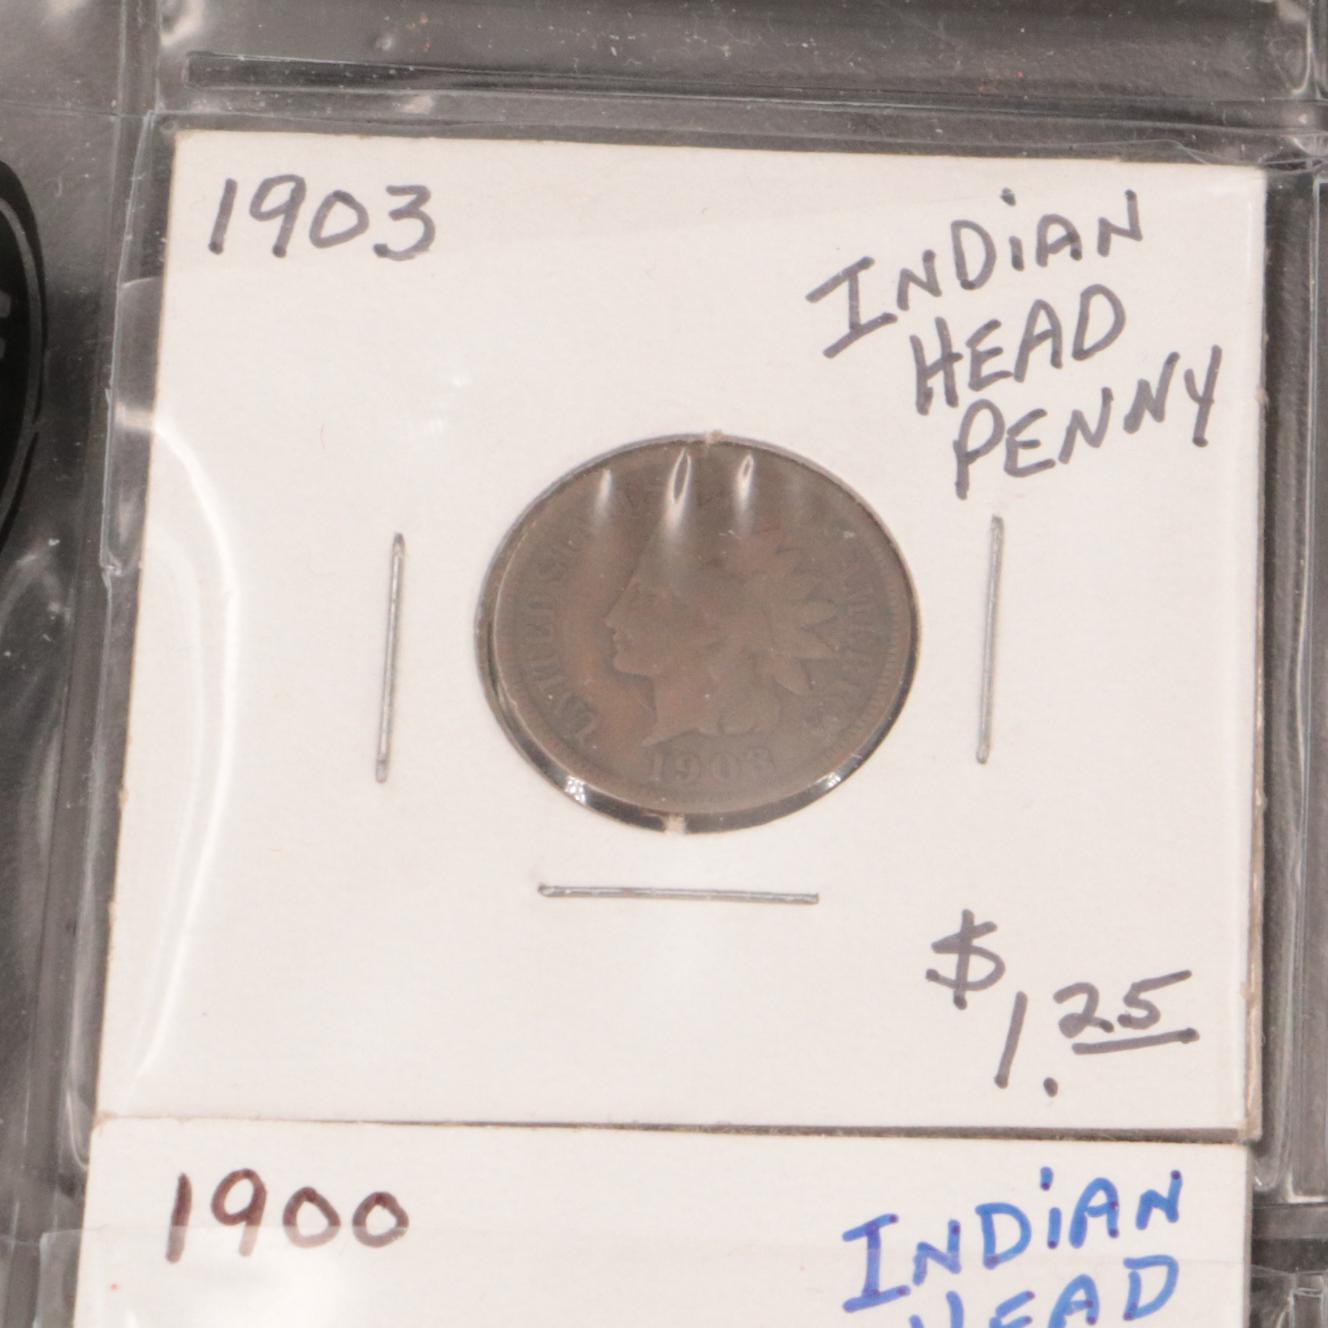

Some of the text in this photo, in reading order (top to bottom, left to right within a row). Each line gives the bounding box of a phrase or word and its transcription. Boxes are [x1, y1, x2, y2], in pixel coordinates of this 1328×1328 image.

[208, 174, 437, 262] 1903
[910, 284, 1126, 416] HEAD
[953, 345, 1223, 500] PENNY
[165, 1167, 410, 1264] 1900
